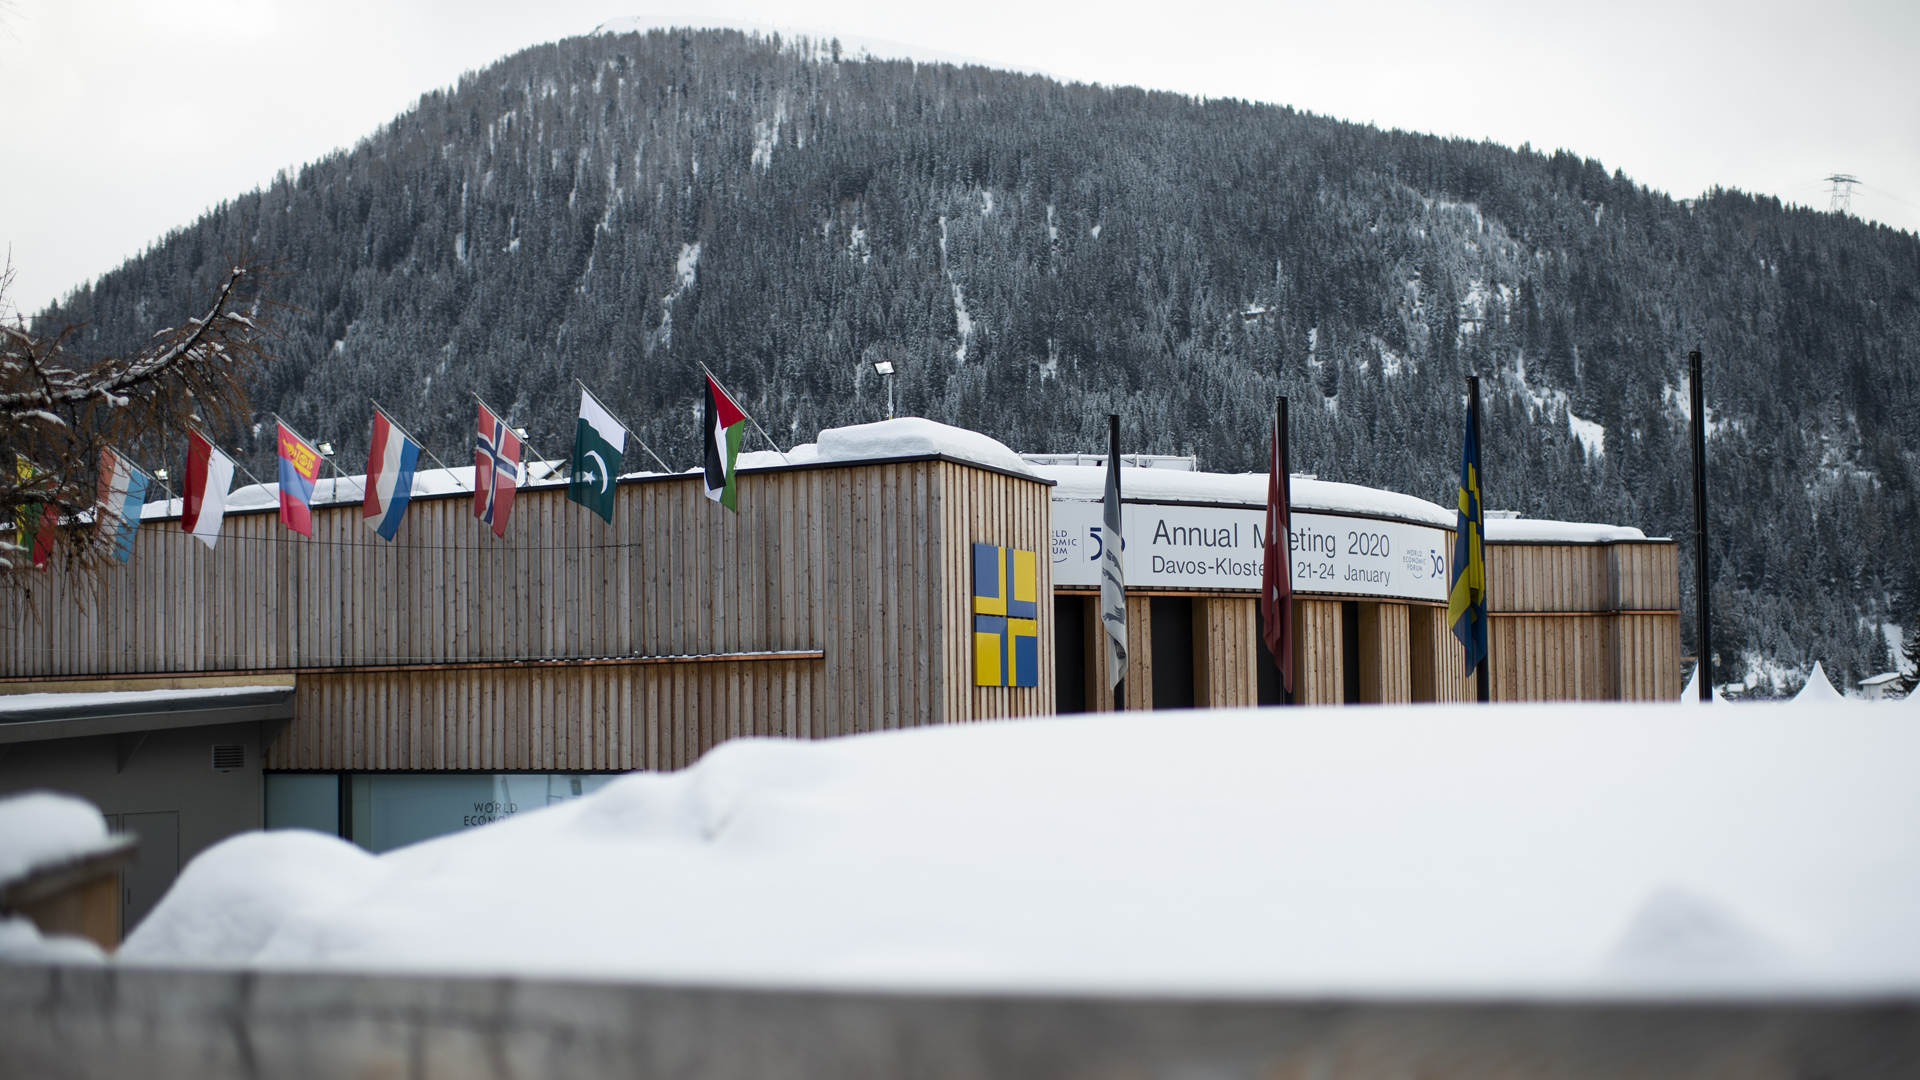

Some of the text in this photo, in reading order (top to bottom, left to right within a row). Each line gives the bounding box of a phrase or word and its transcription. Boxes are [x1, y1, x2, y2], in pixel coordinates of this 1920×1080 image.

[1052, 538, 1077, 546] OMIC
[1152, 519, 1390, 558] Annual Meting 2020
[1406, 549, 1423, 557] WORLD
[1402, 555, 1427, 565] ECONOMIC
[1152, 555, 1391, 587] Davos-Kloste 21-24 January
[1406, 563, 1423, 571] FORUM
[473, 802, 518, 814] WORLD
